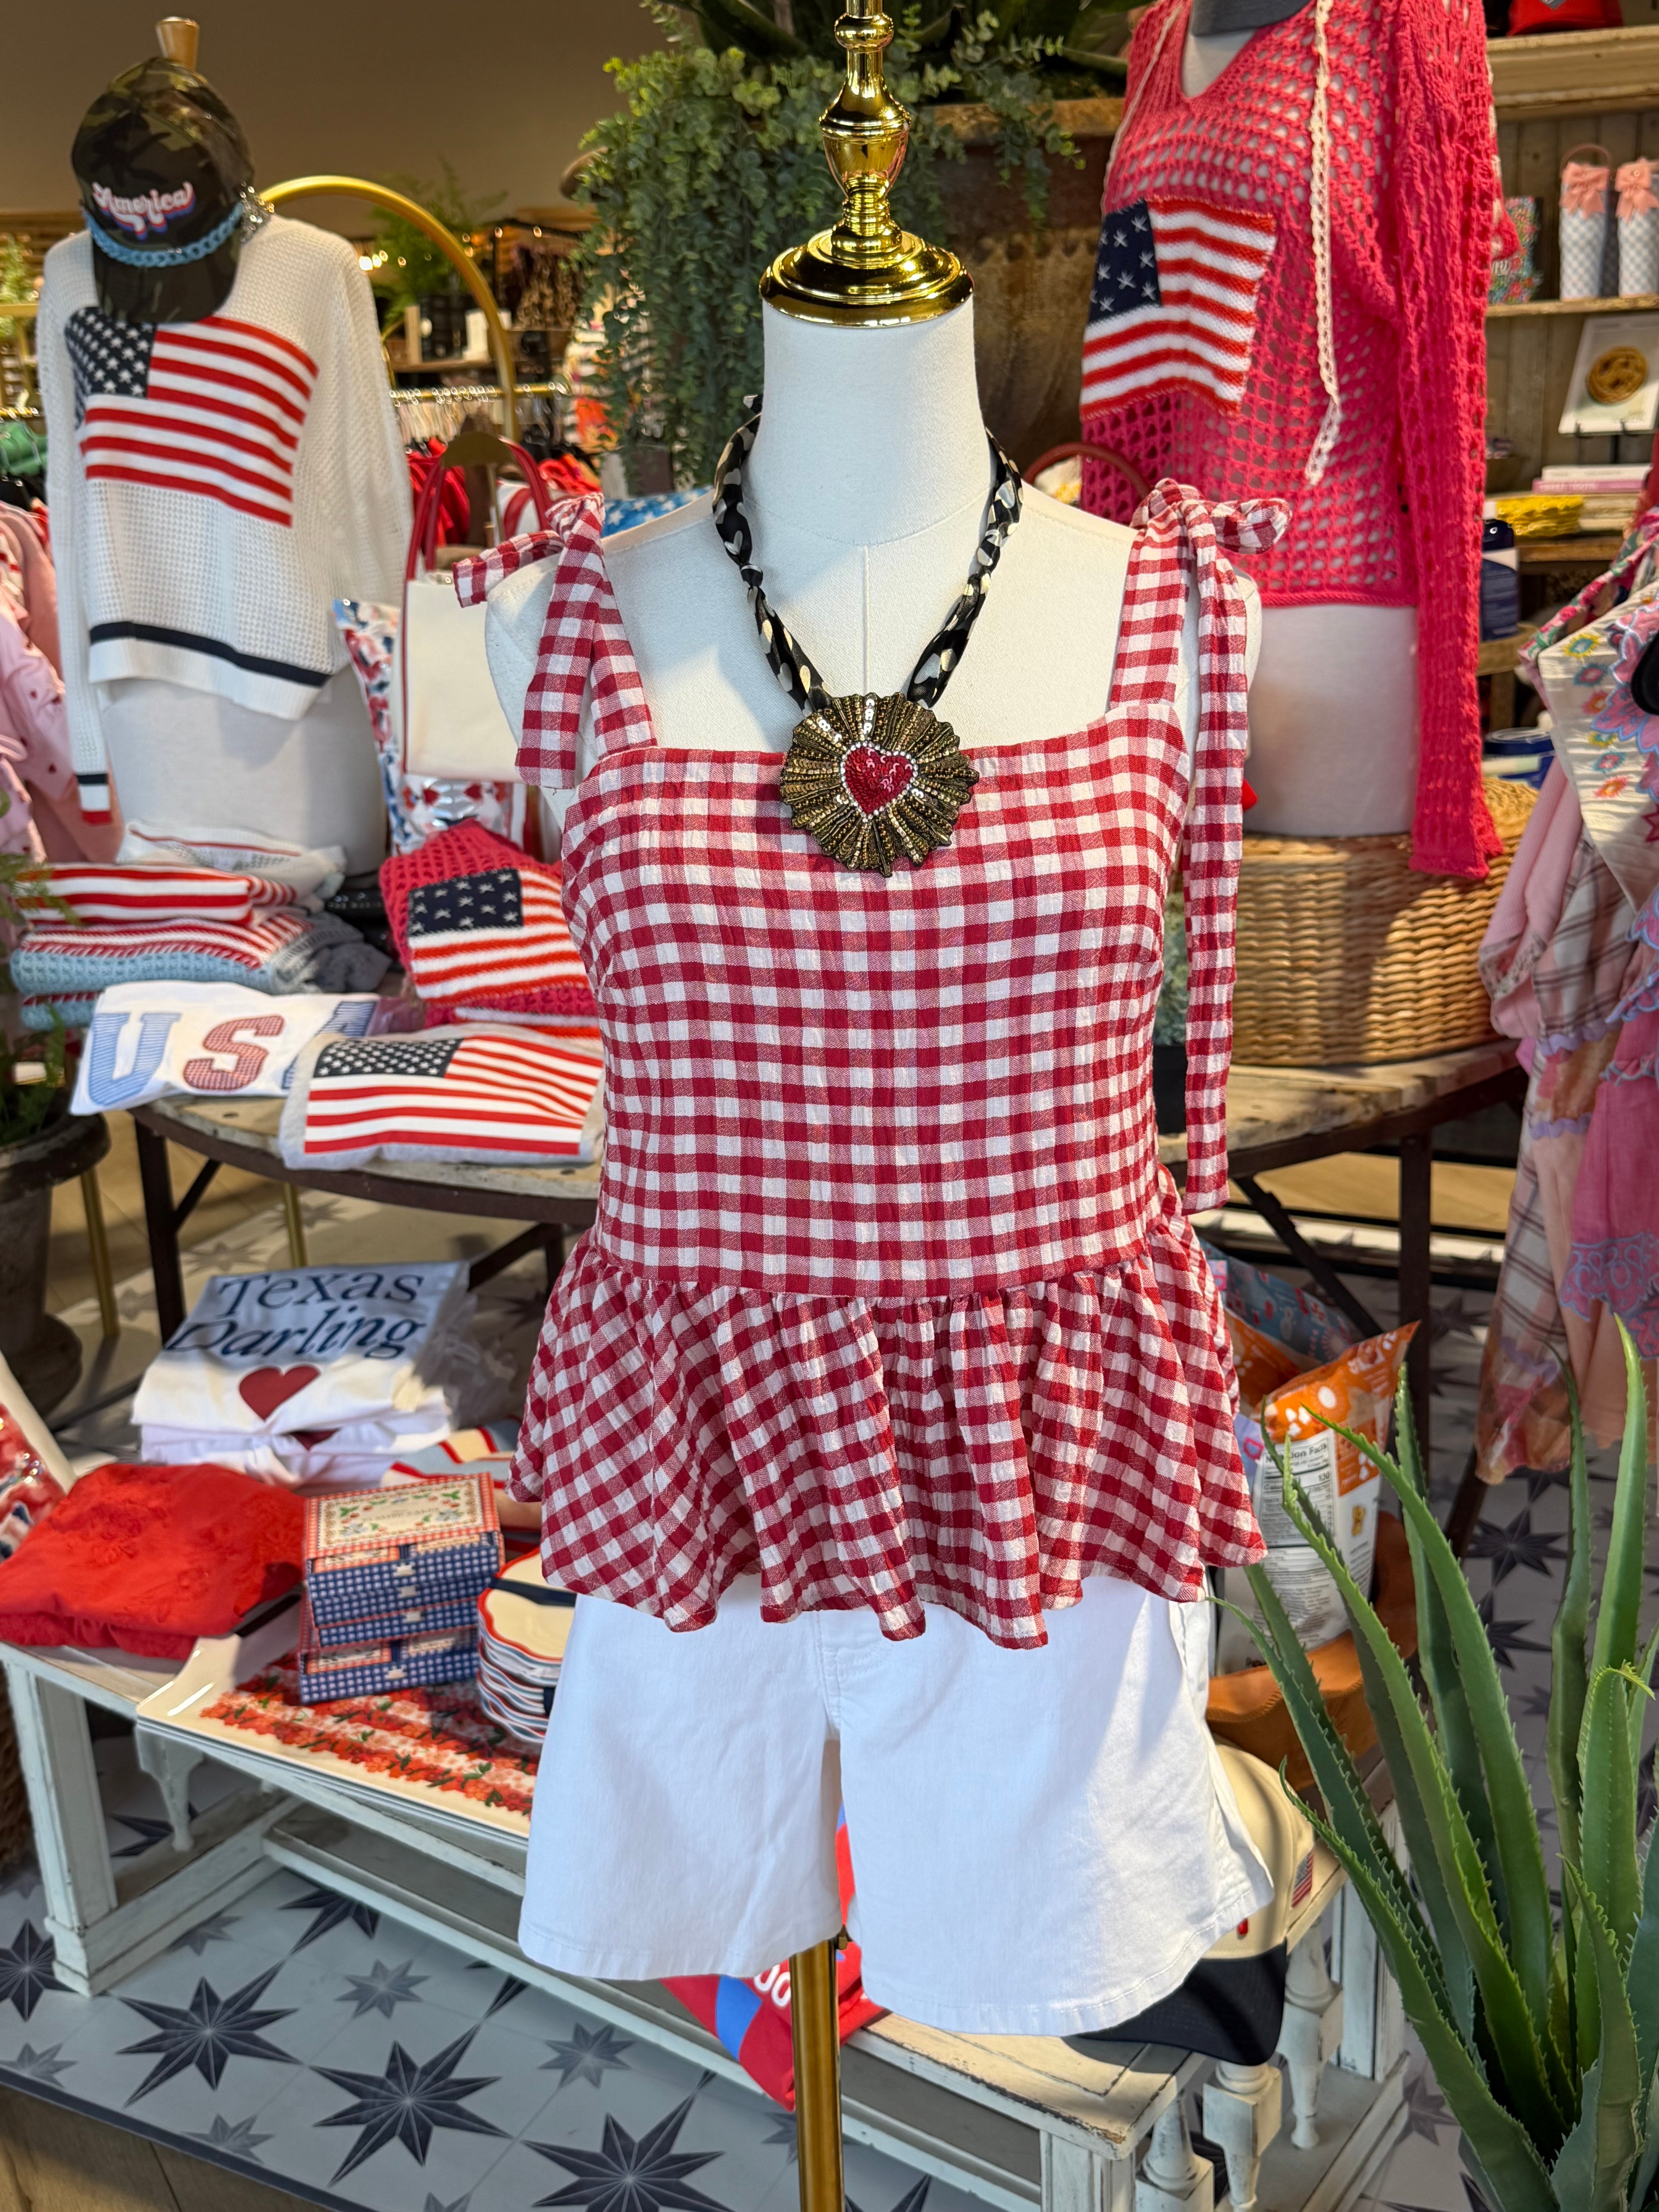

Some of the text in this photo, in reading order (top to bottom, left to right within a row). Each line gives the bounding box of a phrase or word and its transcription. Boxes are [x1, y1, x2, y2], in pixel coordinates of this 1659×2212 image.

[92, 180, 196, 241] America
[218, 1271, 424, 1319] Texas
[164, 1305, 428, 1360] Darling
